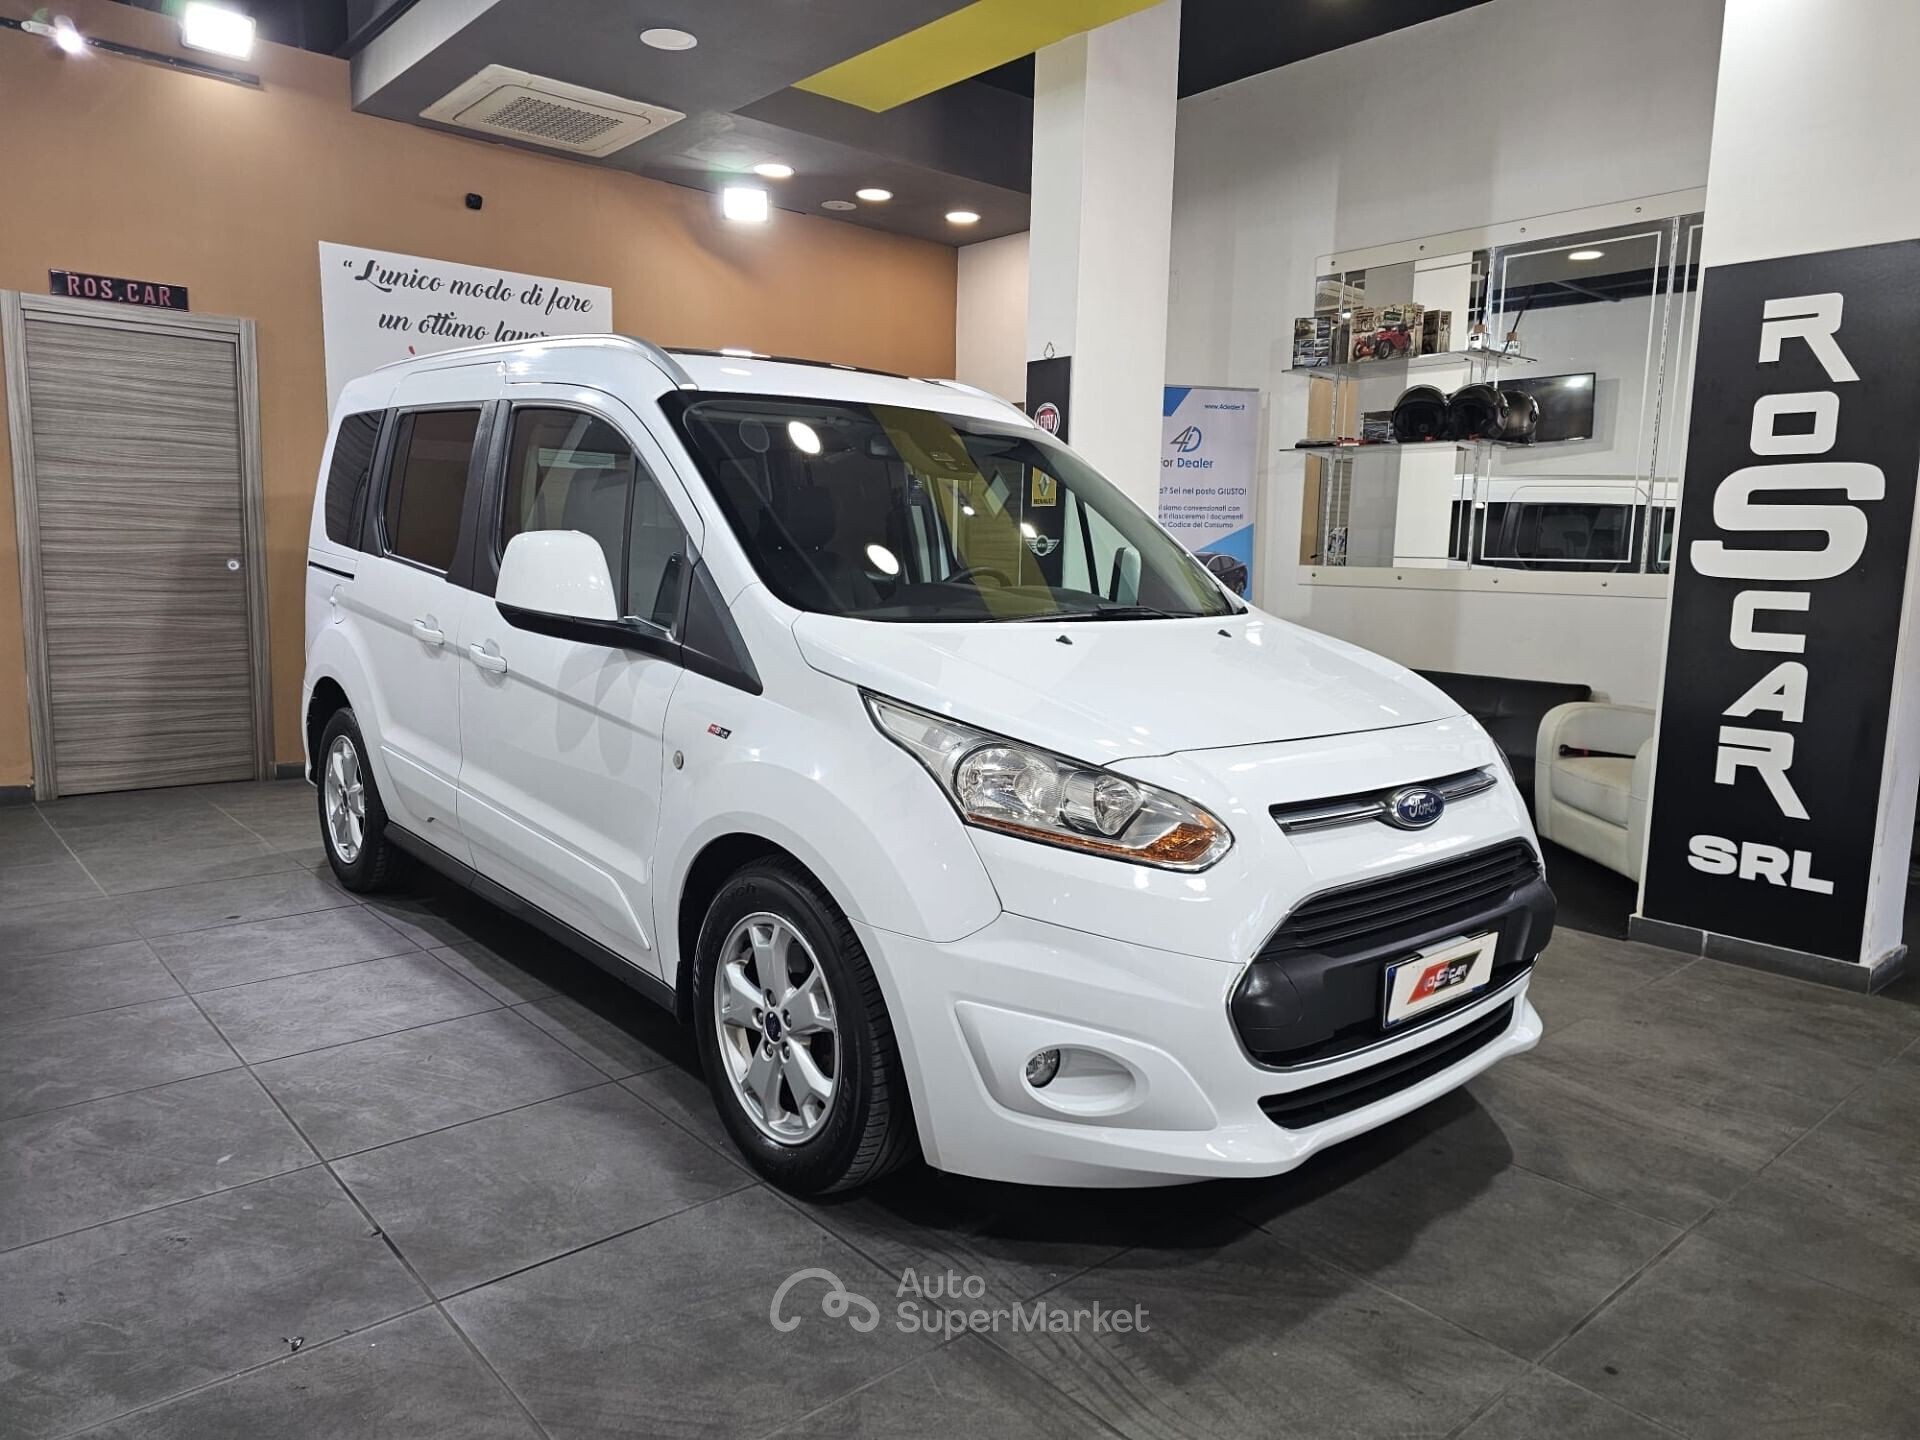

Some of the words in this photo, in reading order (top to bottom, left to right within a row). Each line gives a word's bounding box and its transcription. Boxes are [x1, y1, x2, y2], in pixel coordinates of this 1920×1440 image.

[67, 275, 171, 306] ROS.CAR
[354, 259, 444, 293] L'unico
[450, 278, 515, 302] modo
[520, 284, 544, 306] di
[545, 287, 592, 316] fare
[378, 312, 412, 332] un
[418, 311, 489, 341] ottimo
[1040, 414, 1054, 430] FIAT
[1160, 457, 1174, 468] or
[1177, 457, 1214, 469] Dealer
[1182, 487, 1194, 495] nel
[1195, 487, 1216, 497] posto
[1217, 487, 1247, 496] GIUSTO!
[1192, 521, 1203, 529] del
[1407, 793, 1437, 818] Ford
[1687, 834, 1835, 896] SRL
